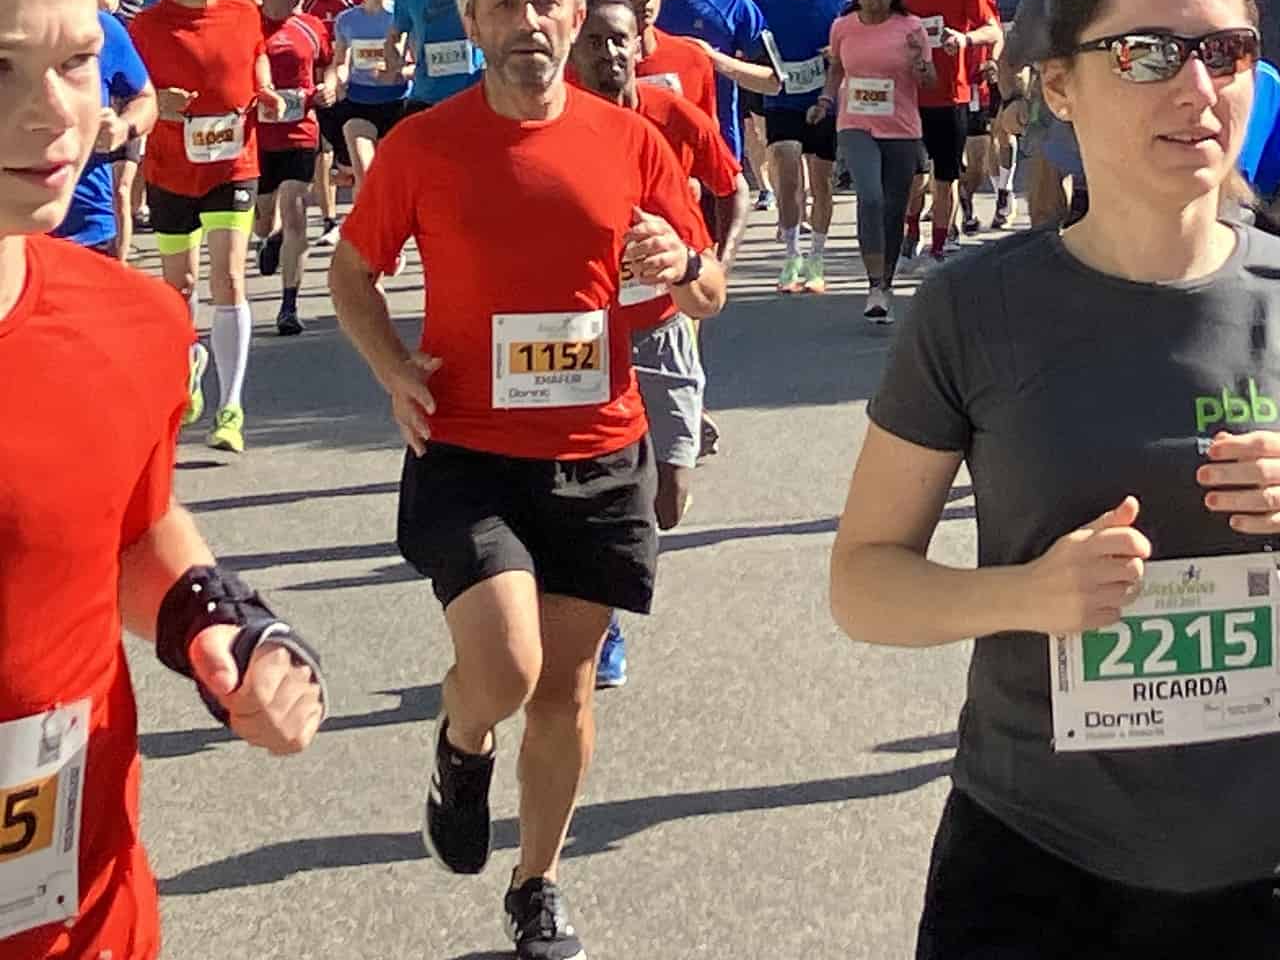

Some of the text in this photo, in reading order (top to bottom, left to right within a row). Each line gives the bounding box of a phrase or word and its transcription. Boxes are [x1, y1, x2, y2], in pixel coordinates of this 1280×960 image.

[518, 343, 594, 372] 1152
[1195, 376, 1279, 433] pbb
[1097, 610, 1259, 677] 2215
[1133, 676, 1228, 702] RICARDA
[1084, 706, 1165, 728] Dorint
